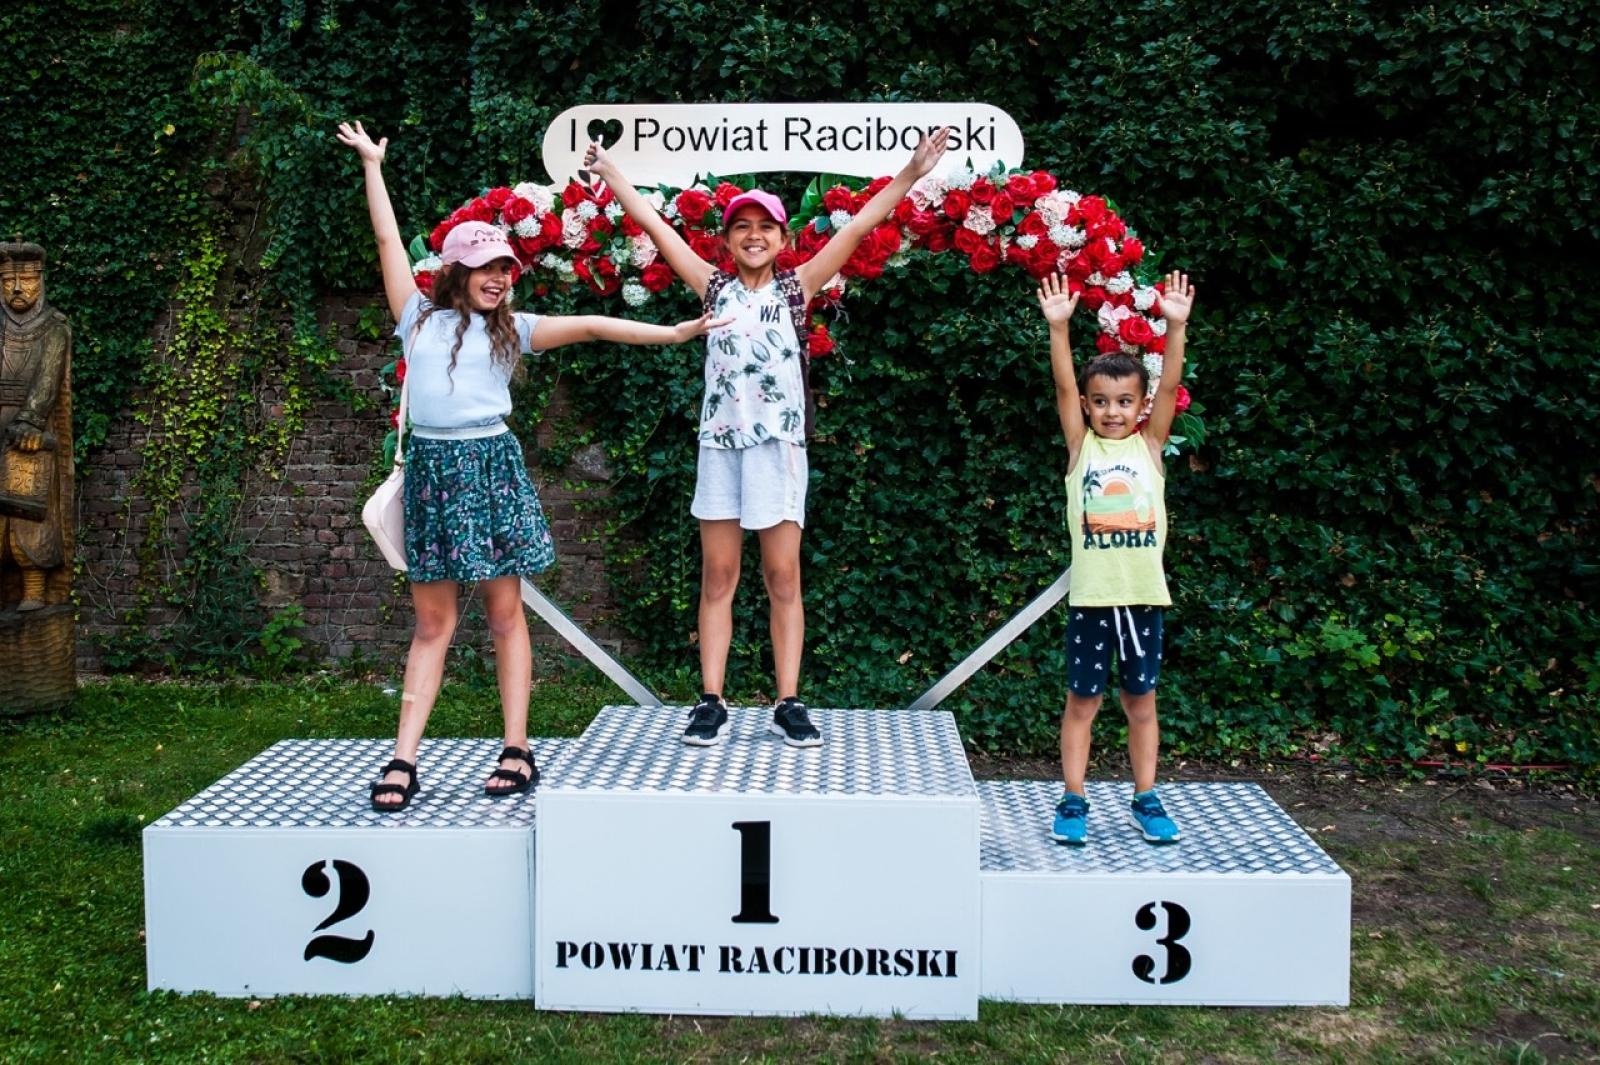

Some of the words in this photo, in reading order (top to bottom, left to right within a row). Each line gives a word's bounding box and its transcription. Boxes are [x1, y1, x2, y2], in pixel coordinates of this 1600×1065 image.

[570, 118, 577, 152] I
[634, 117, 768, 152] Powiat
[784, 117, 996, 152] Raciborski
[760, 304, 781, 323] WA
[1083, 530, 1157, 549] ALOHA
[731, 820, 780, 924] 1
[301, 859, 375, 964] 2
[556, 941, 706, 972] POWIAT
[718, 945, 958, 978] RACIBORSKI
[1132, 900, 1192, 985] 3
